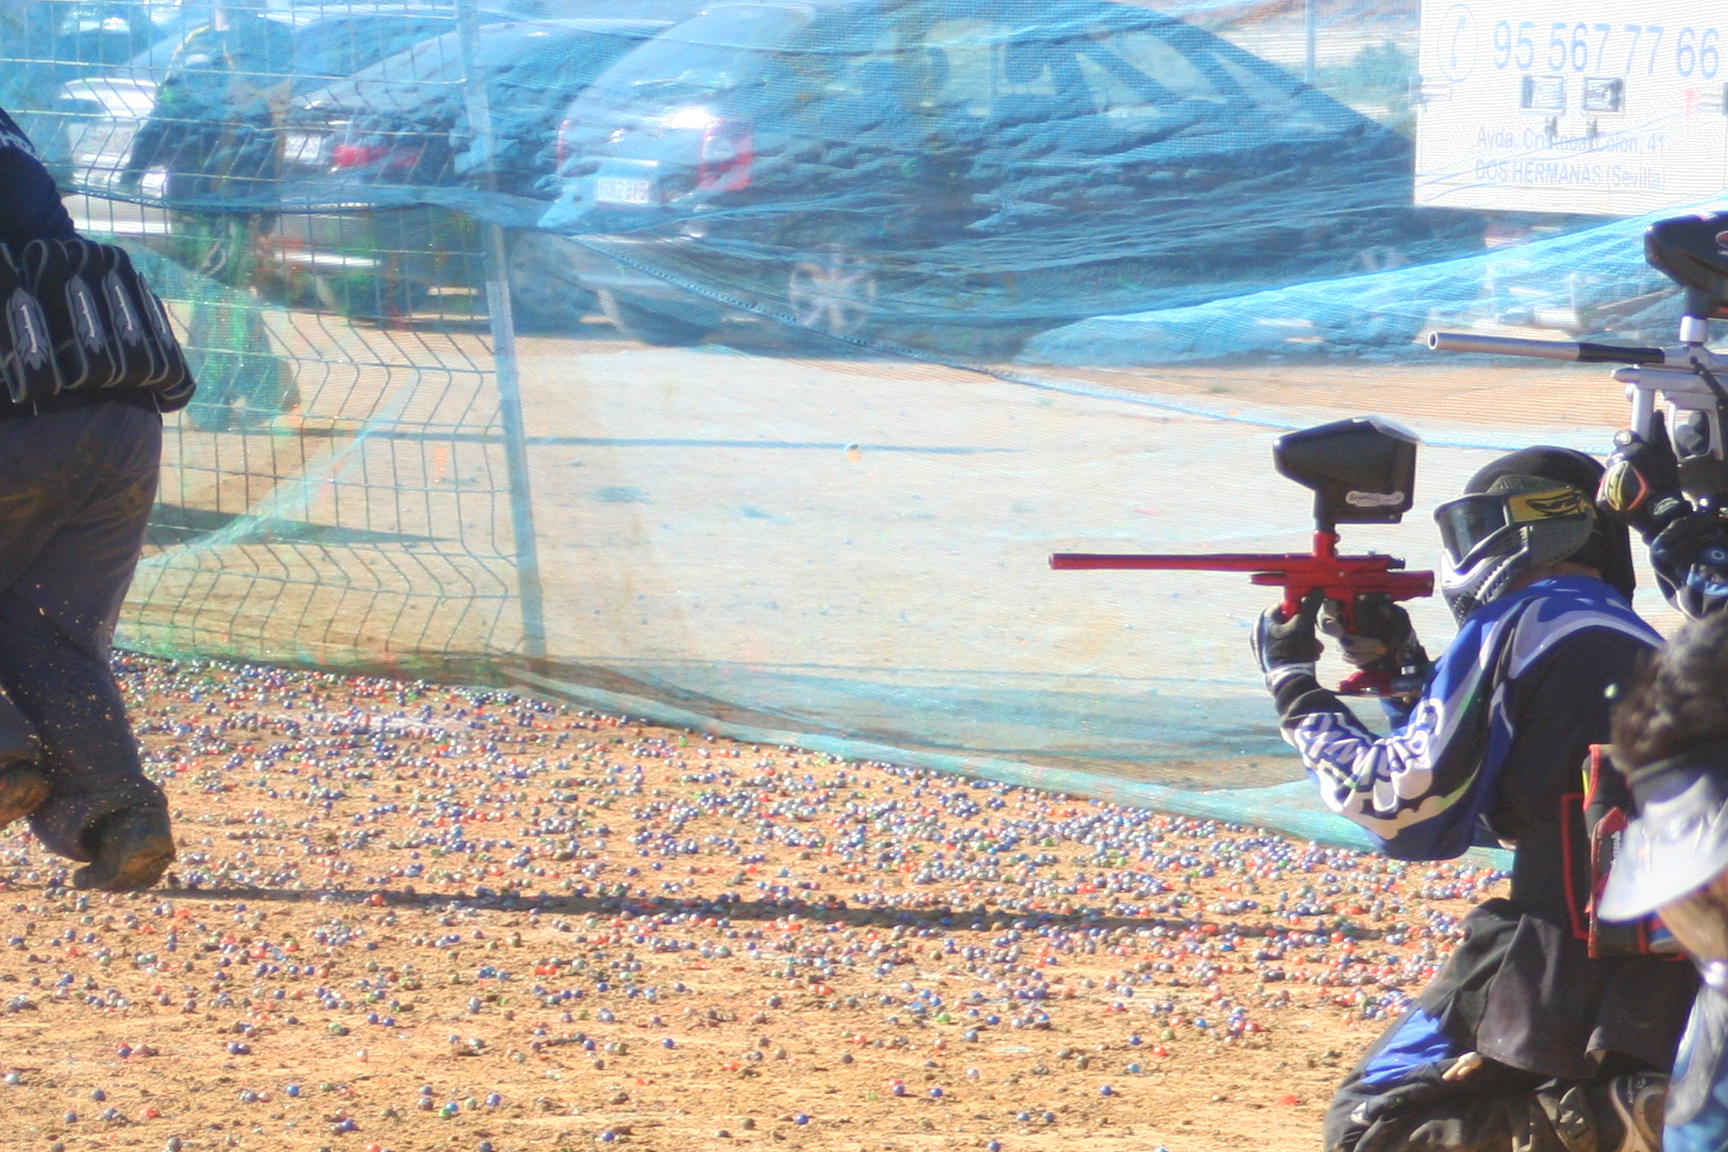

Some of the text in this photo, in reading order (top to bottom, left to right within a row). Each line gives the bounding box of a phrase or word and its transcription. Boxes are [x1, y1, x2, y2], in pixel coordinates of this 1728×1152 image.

[1493, 20, 1719, 79] 95 567 77 66
[1646, 133, 1665, 153] 41
[1476, 159, 1508, 181] DOS
[1513, 162, 1601, 185] HERMANAS
